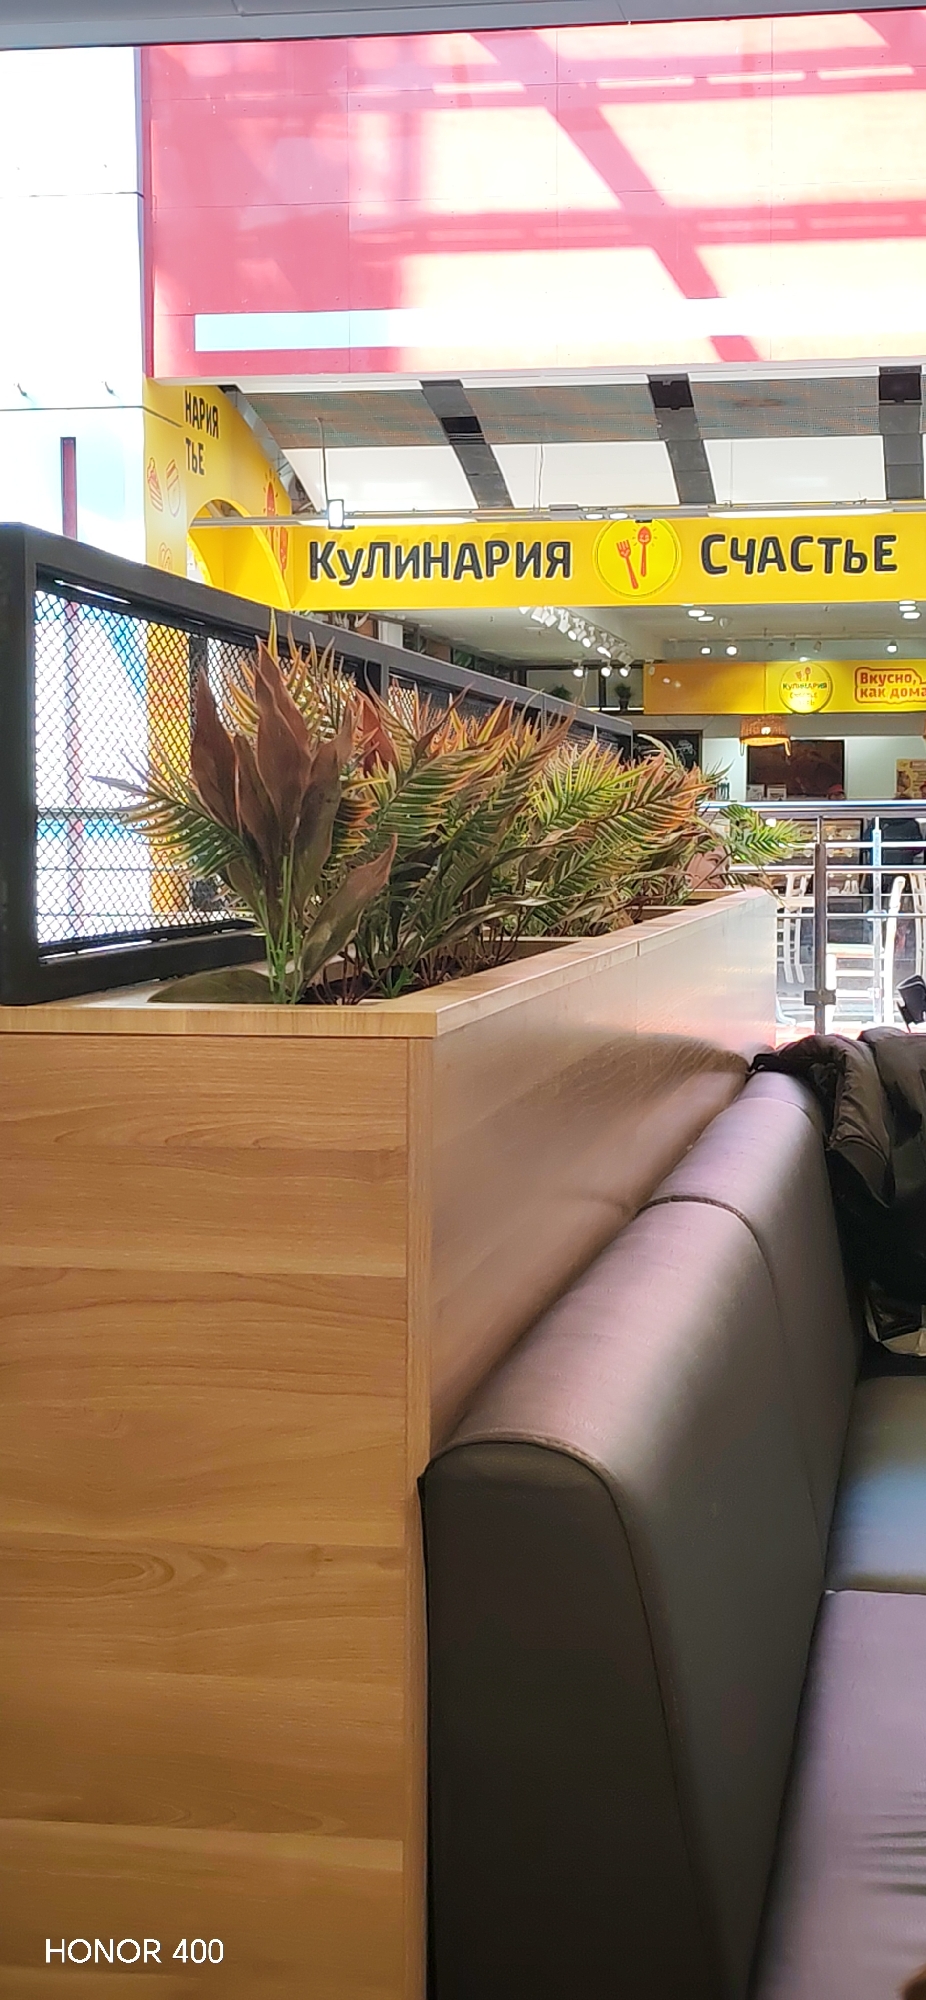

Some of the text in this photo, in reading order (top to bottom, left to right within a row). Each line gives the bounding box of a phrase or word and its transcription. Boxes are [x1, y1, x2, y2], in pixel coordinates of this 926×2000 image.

[700, 533, 898, 575] СЧАСТЬЕ
[860, 672, 917, 687] Вкусно,
[860, 687, 886, 698] как
